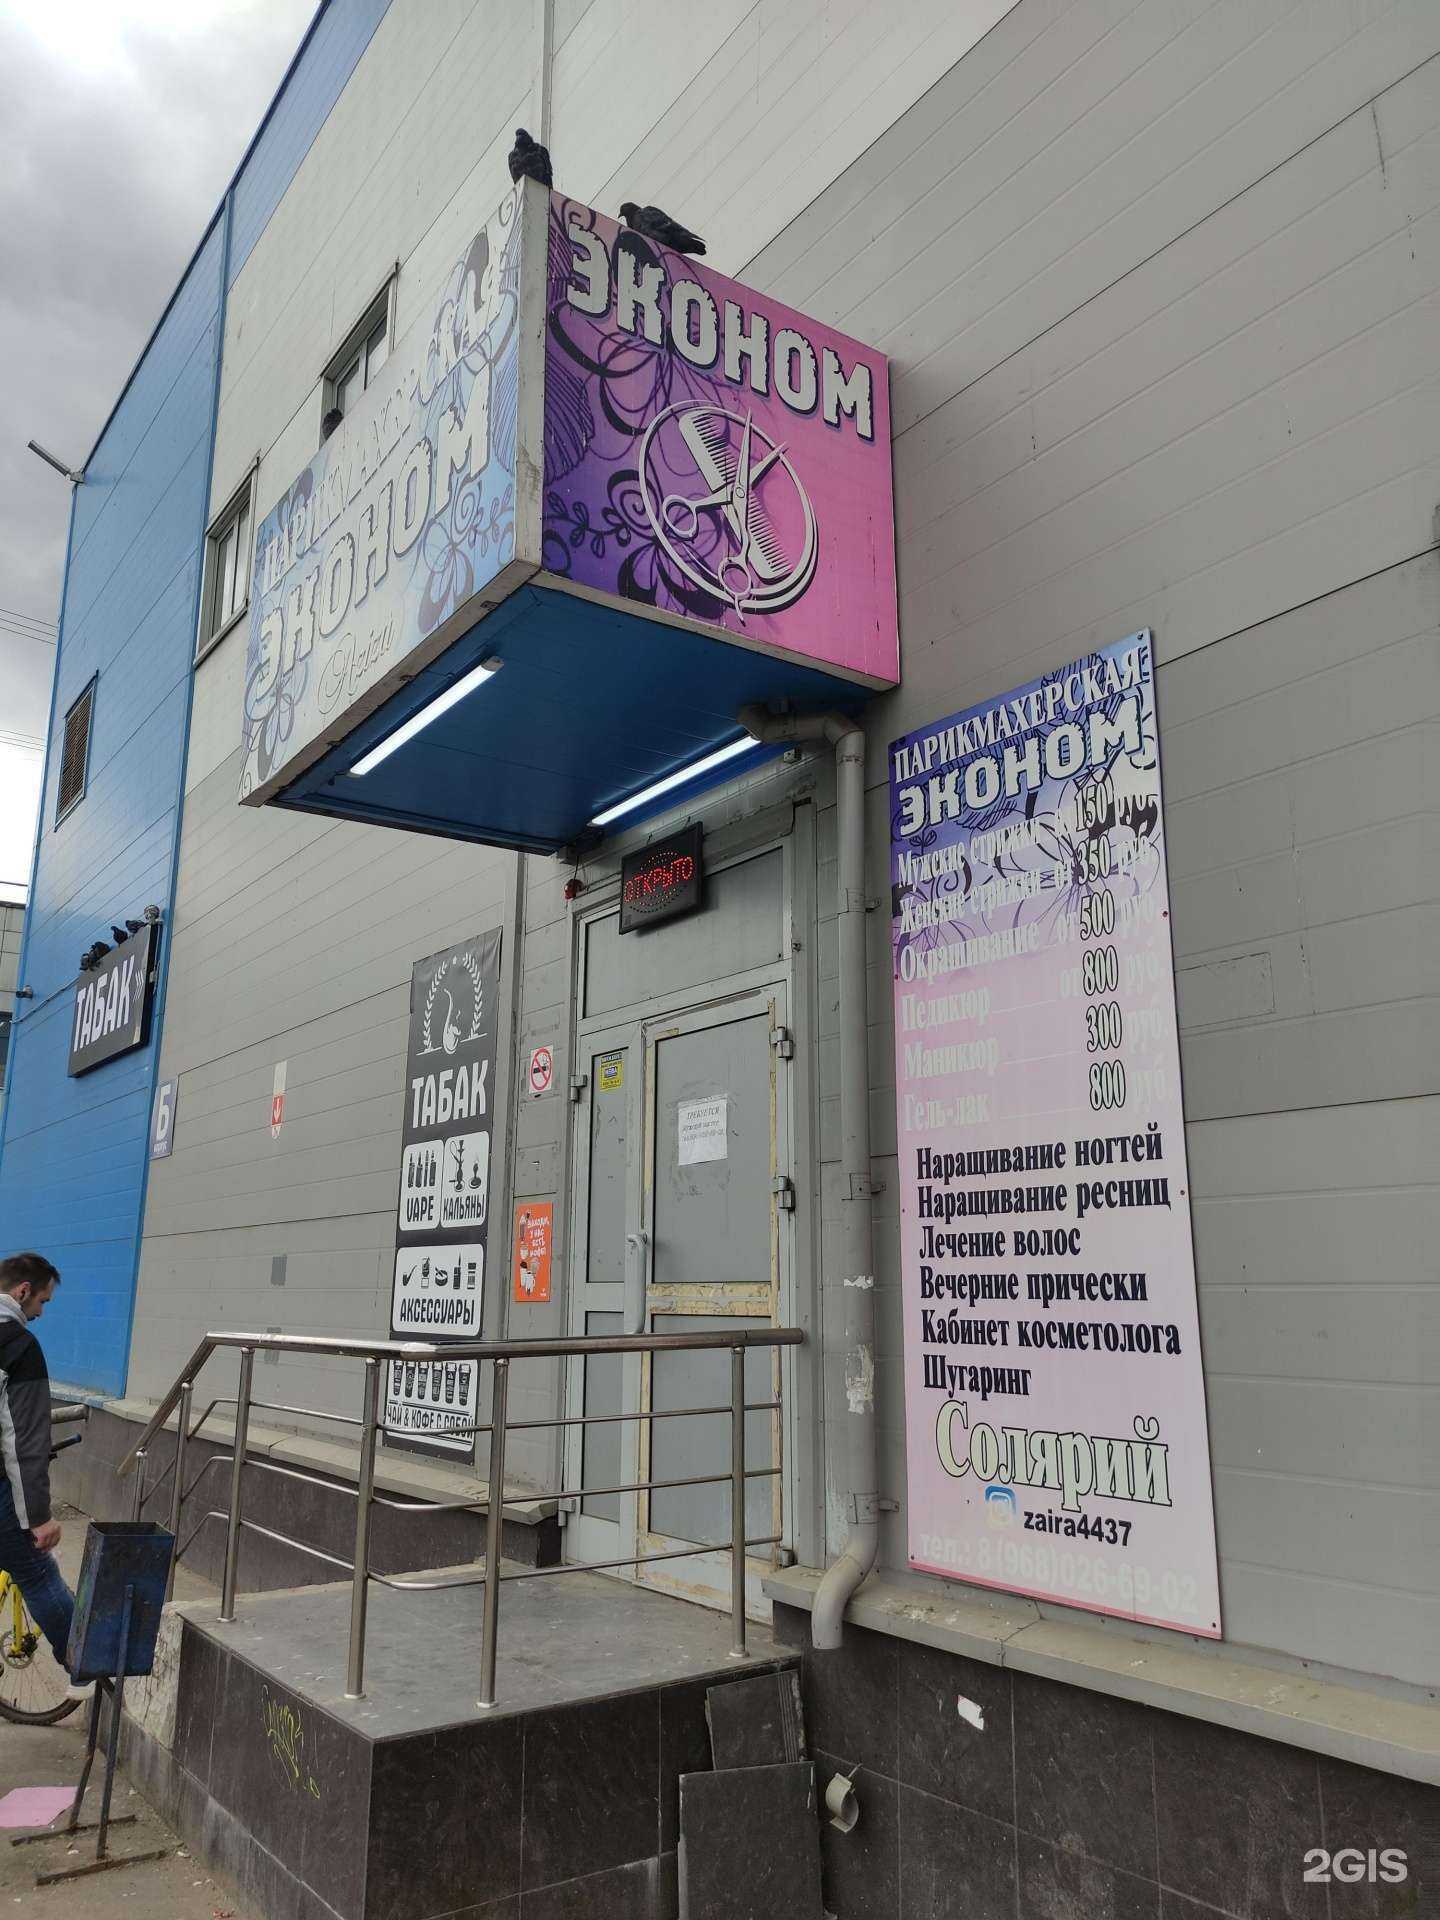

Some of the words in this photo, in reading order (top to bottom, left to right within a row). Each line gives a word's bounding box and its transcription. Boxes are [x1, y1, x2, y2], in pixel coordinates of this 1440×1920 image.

[568, 223, 874, 441] ЭКОНОМ
[253, 363, 492, 701] ЭКОНОМ
[894, 647, 1142, 783] ПАРИКМАХЕРСКАЯ
[898, 695, 1144, 837] ЭКОНОМ
[898, 842, 965, 892] Мужские
[971, 818, 1041, 868] стрижки
[1074, 781, 1109, 832] 150
[624, 856, 693, 903] ОТКРЫТО
[900, 892, 966, 933] Женские
[1077, 834, 1111, 886] 350
[900, 922, 1040, 986] Окрашивание
[1080, 889, 1115, 941] 500
[73, 955, 136, 1053] ТАБАК
[902, 988, 992, 1032] Педикюр
[1060, 966, 1083, 999] от
[1082, 944, 1119, 996] 800
[903, 1038, 998, 1081] Маникюр
[1086, 1000, 1122, 1053] 300
[156, 1084, 171, 1141] Б
[412, 1059, 489, 1128] ТАБАК
[903, 1093, 991, 1132] Гель-лак
[1089, 1058, 1126, 1111] 800
[916, 1141, 1067, 1185] Наращивание
[1074, 1121, 1163, 1167] ногтей
[406, 1196, 434, 1223] VAPE
[443, 1194, 485, 1221] КАЛЬЯНЫ
[917, 1183, 1068, 1225] Наращивание
[1076, 1177, 1172, 1219] ресниц
[919, 1225, 1006, 1258] Лечение
[1013, 1227, 1081, 1256] волос
[400, 1298, 474, 1325] АКСЕССУАРЫ
[919, 1265, 1020, 1308] Вечерние
[1026, 1271, 1149, 1309] прически
[920, 1307, 1010, 1346] Кабинет
[1017, 1318, 1182, 1355] косметолога
[923, 1353, 1032, 1401] Шугаринг
[387, 1403, 402, 1425] ЧАЙ
[404, 1408, 410, 1427] &
[412, 1409, 434, 1429] КОФЕ
[935, 1400, 1172, 1513] Солярий
[1023, 1509, 1132, 1547] zaira4437
